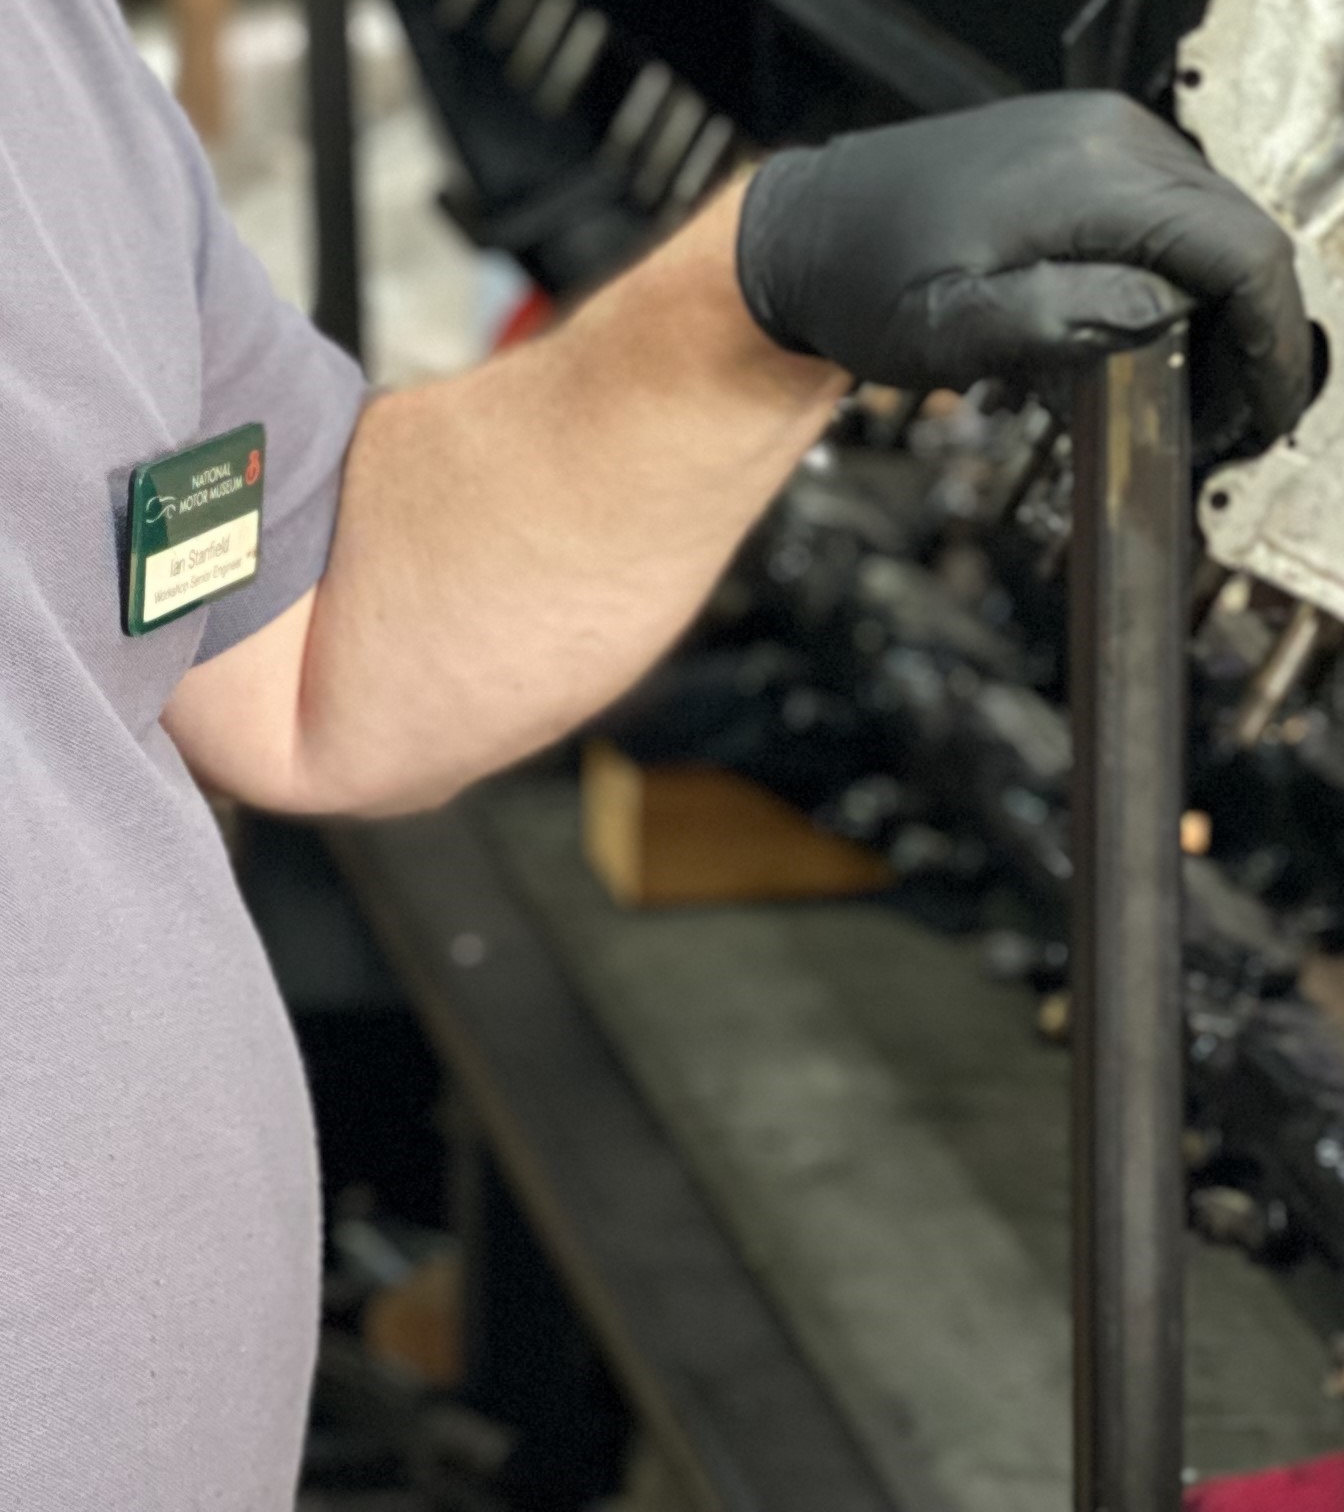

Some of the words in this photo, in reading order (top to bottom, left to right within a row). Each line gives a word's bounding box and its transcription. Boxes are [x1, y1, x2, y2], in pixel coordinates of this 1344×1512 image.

[192, 462, 231, 488] NATIONAL
[179, 489, 208, 514] MOTOR
[209, 475, 243, 499] MUSEUM
[170, 558, 186, 578] Ian
